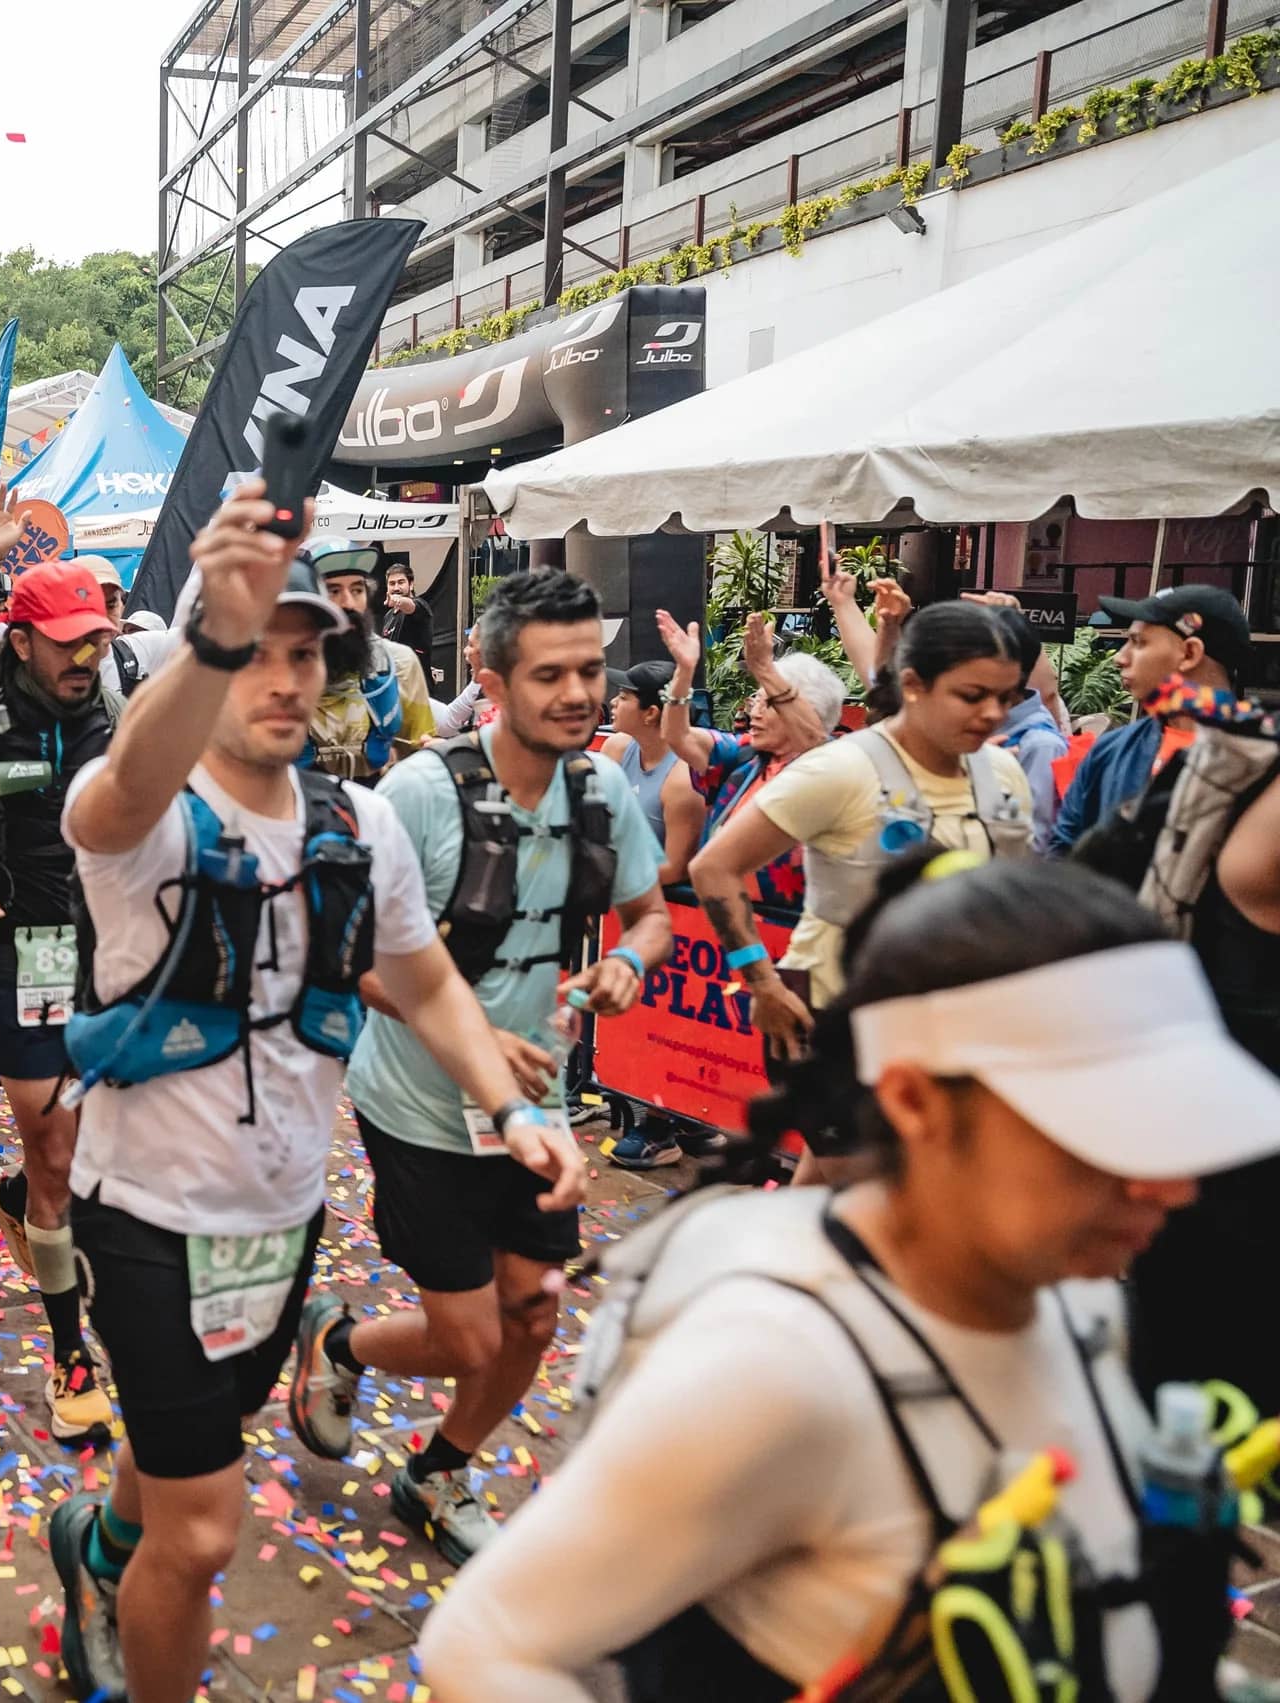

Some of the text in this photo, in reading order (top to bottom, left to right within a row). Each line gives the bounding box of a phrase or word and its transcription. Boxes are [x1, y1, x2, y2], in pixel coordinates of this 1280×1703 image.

[544, 348, 599, 375] Julbo
[635, 349, 692, 365] Julbo
[338, 388, 442, 448] ulbo
[95, 472, 171, 496] HOK
[346, 513, 415, 531] Julbo
[36, 946, 75, 973] 89
[640, 969, 753, 1036] PLAY
